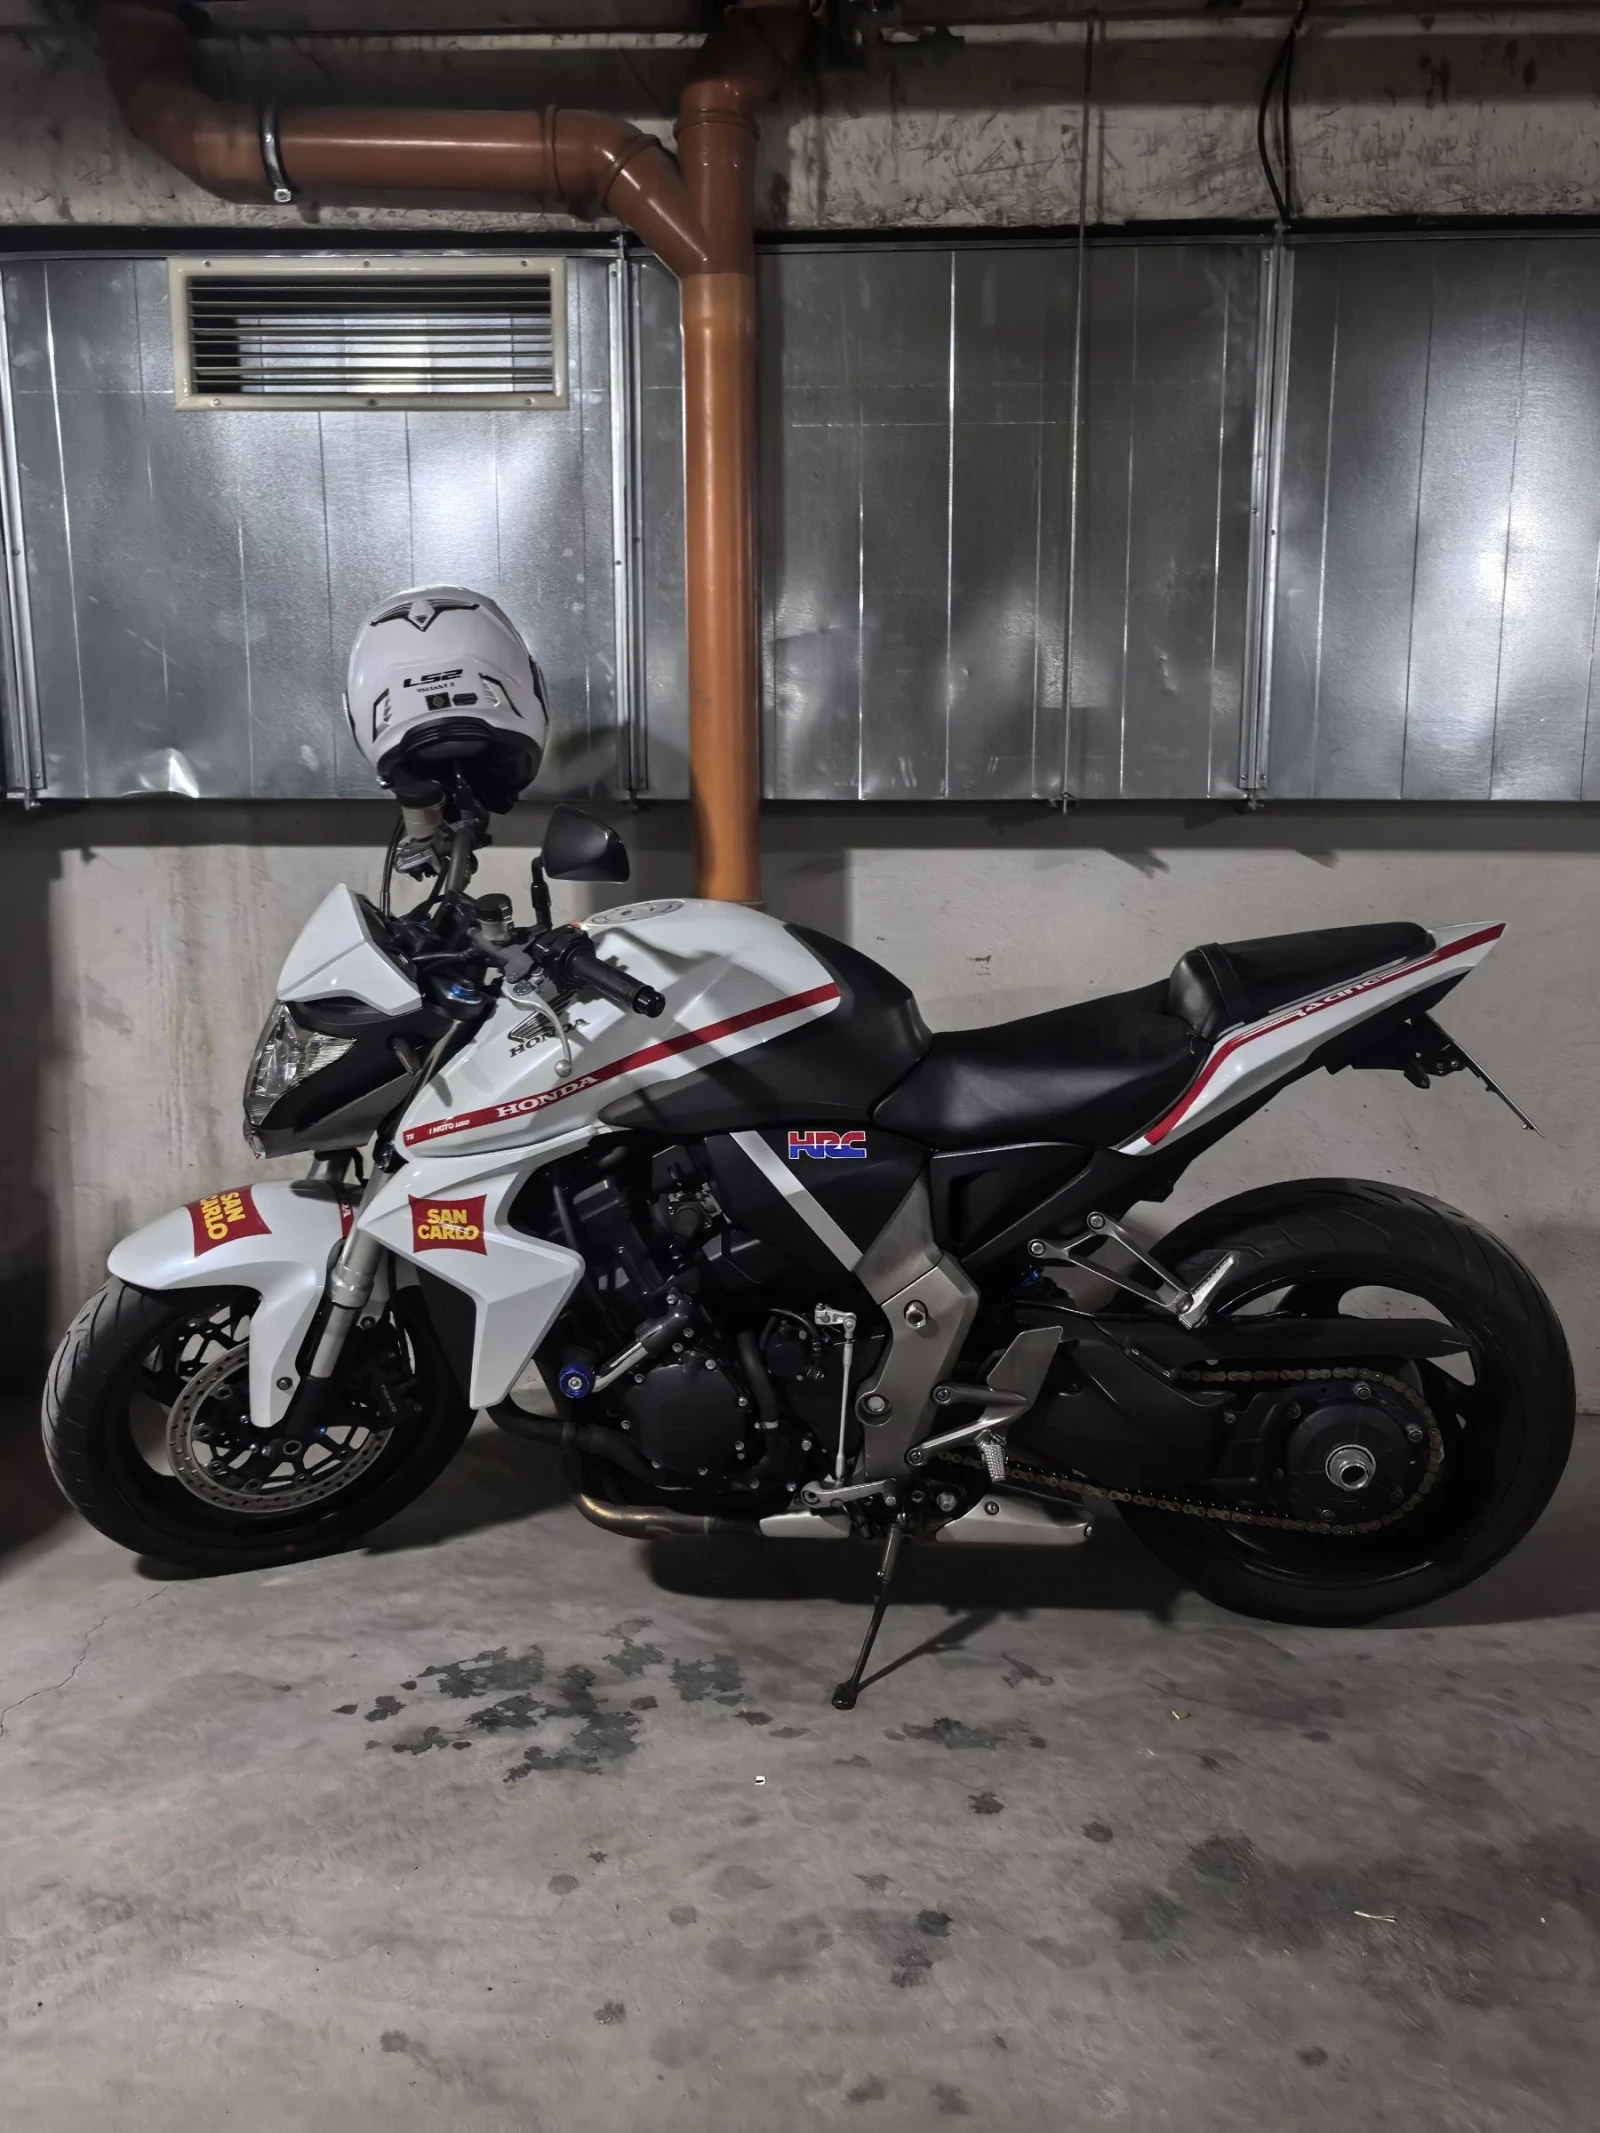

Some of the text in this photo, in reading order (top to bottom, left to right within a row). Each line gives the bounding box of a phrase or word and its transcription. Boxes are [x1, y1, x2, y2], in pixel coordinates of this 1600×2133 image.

[403, 669, 463, 688] LS2
[496, 1076, 598, 1117] HONDA
[432, 1122, 454, 1134] MOTO
[788, 1131, 867, 1159] HRC
[220, 1191, 246, 1222] SAN
[427, 1208, 467, 1224] SAN
[417, 1224, 479, 1240] CARLO
